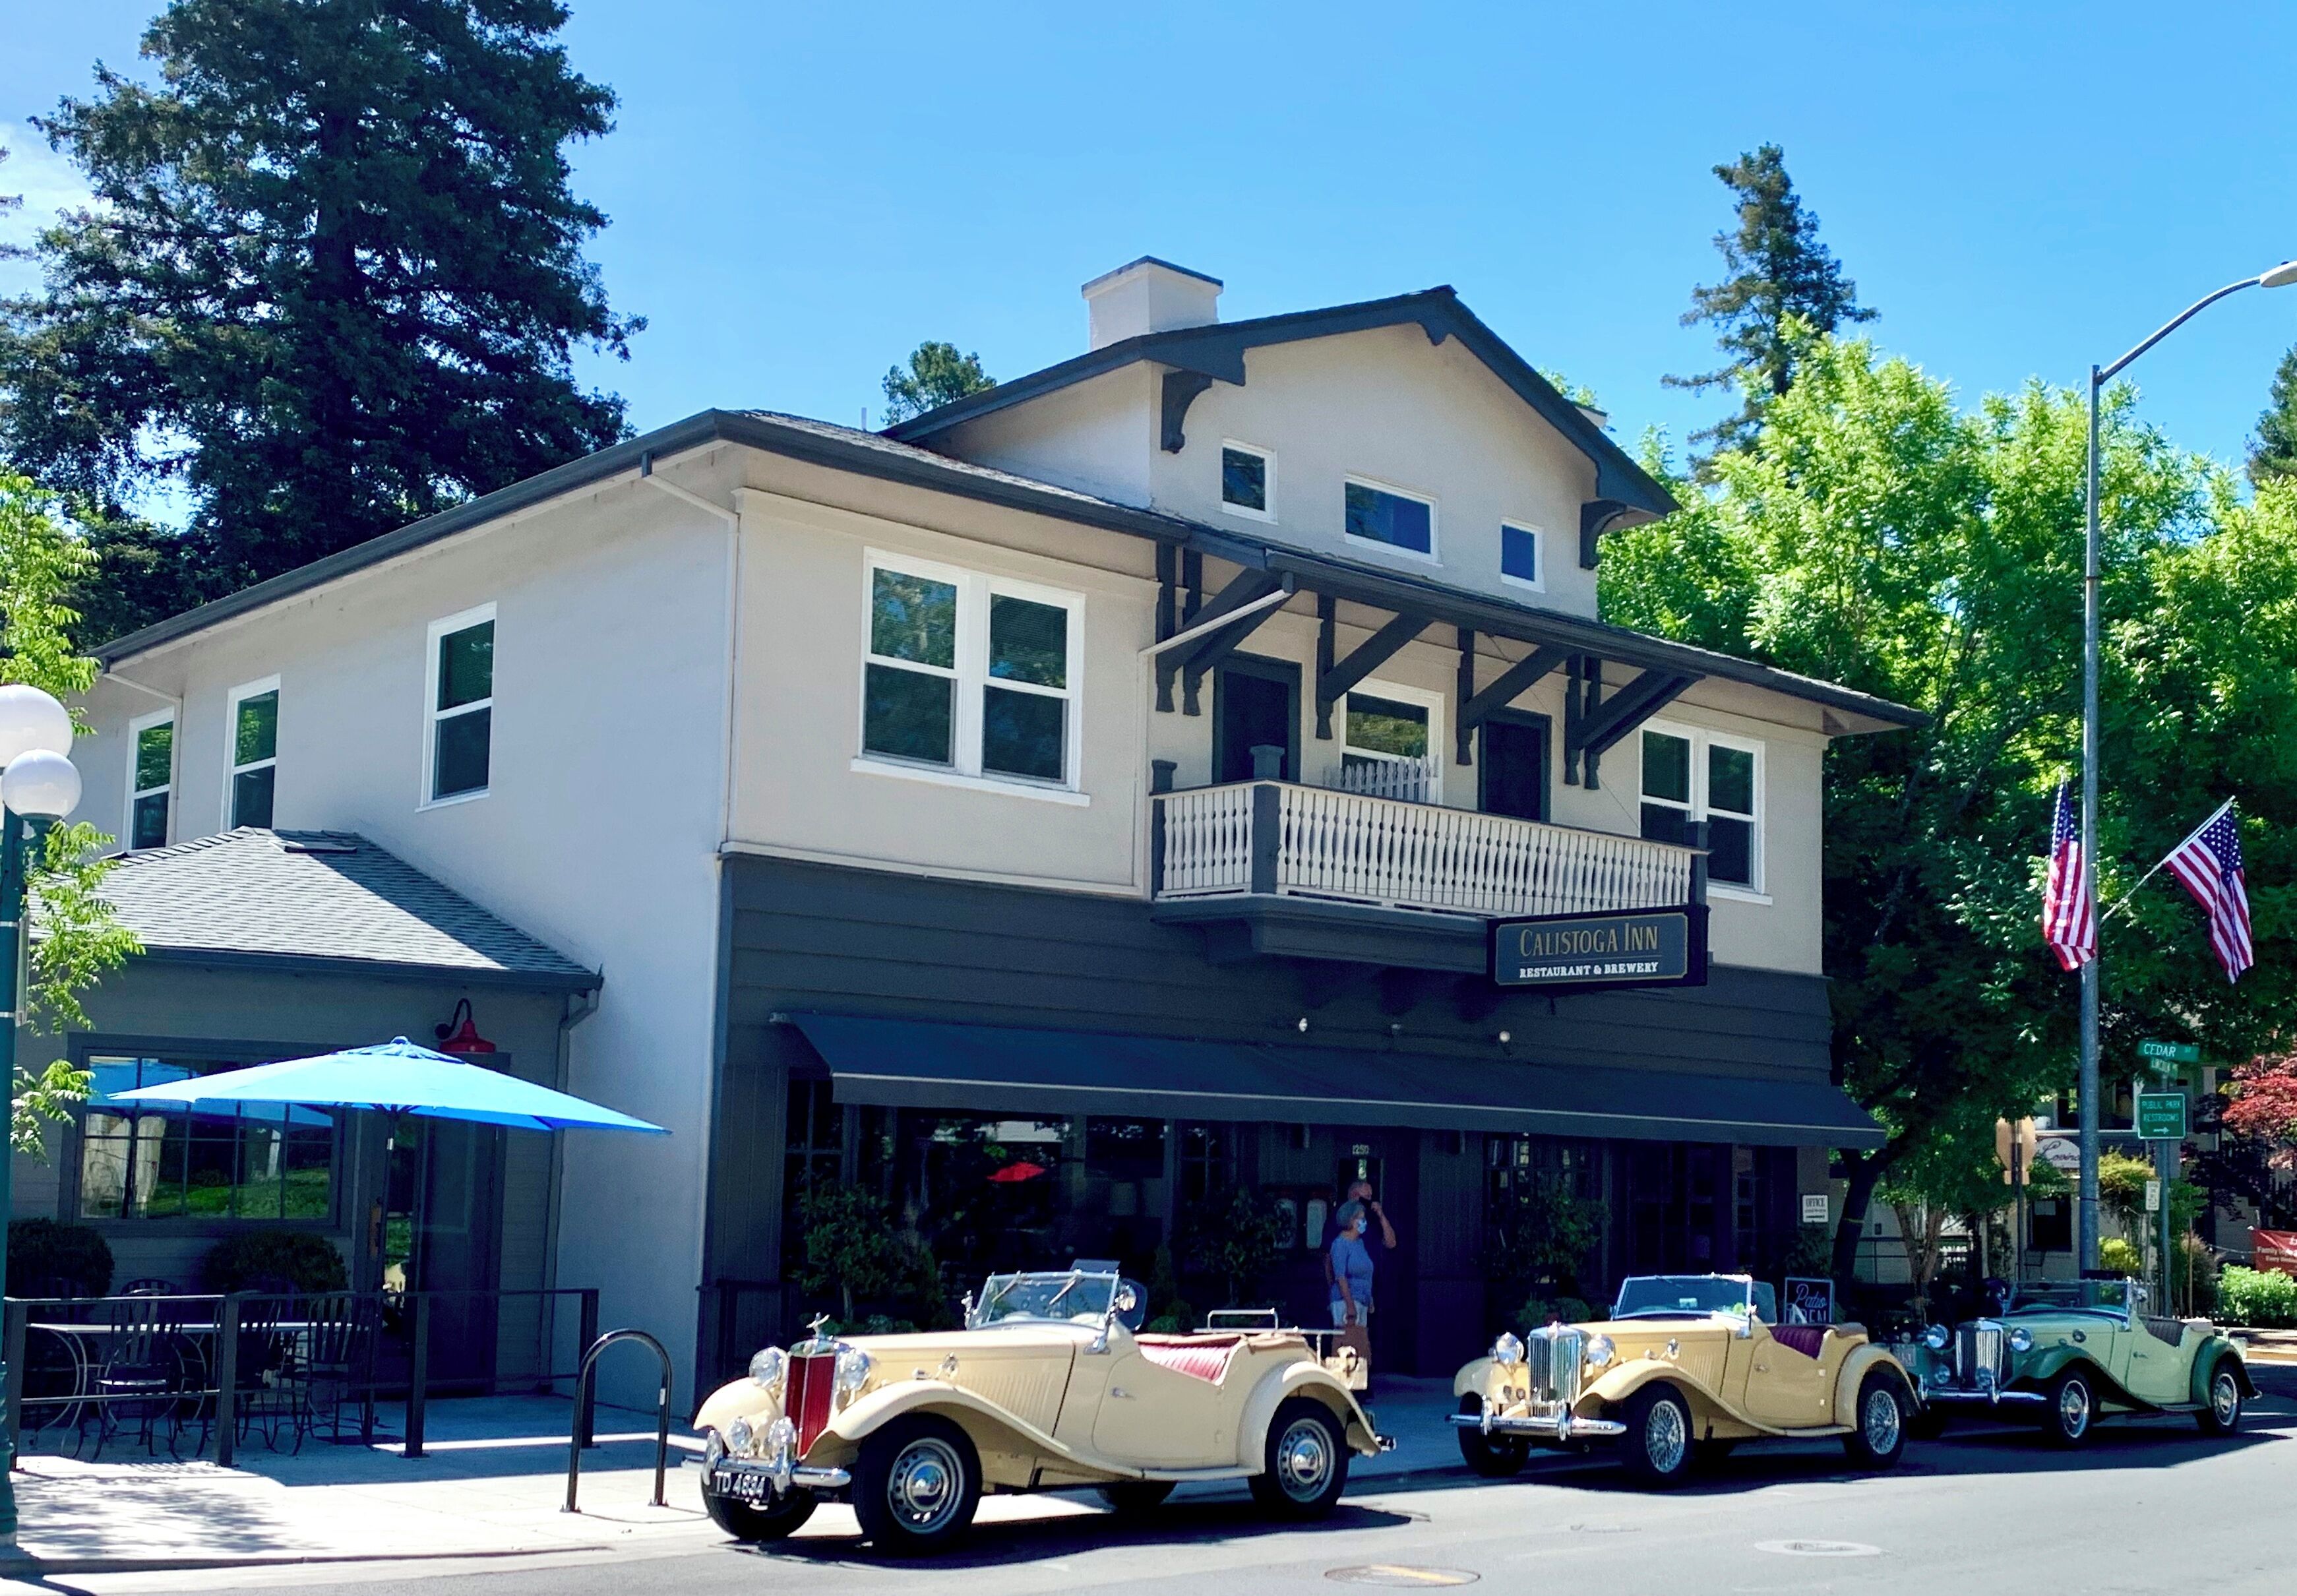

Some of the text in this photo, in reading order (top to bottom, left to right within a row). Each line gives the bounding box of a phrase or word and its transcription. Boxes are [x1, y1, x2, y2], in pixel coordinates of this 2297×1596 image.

[1519, 923, 1658, 956] CALISTOGA INN
[1519, 962, 1659, 978] RESTAURANT & BREWERY
[2144, 1043, 2176, 1057] CEDAR
[2143, 1113, 2180, 1122] RESTROOMS
[1806, 1198, 1825, 1207] OFFICE
[1796, 1283, 1826, 1307] Patio
[715, 1471, 731, 1492] TD
